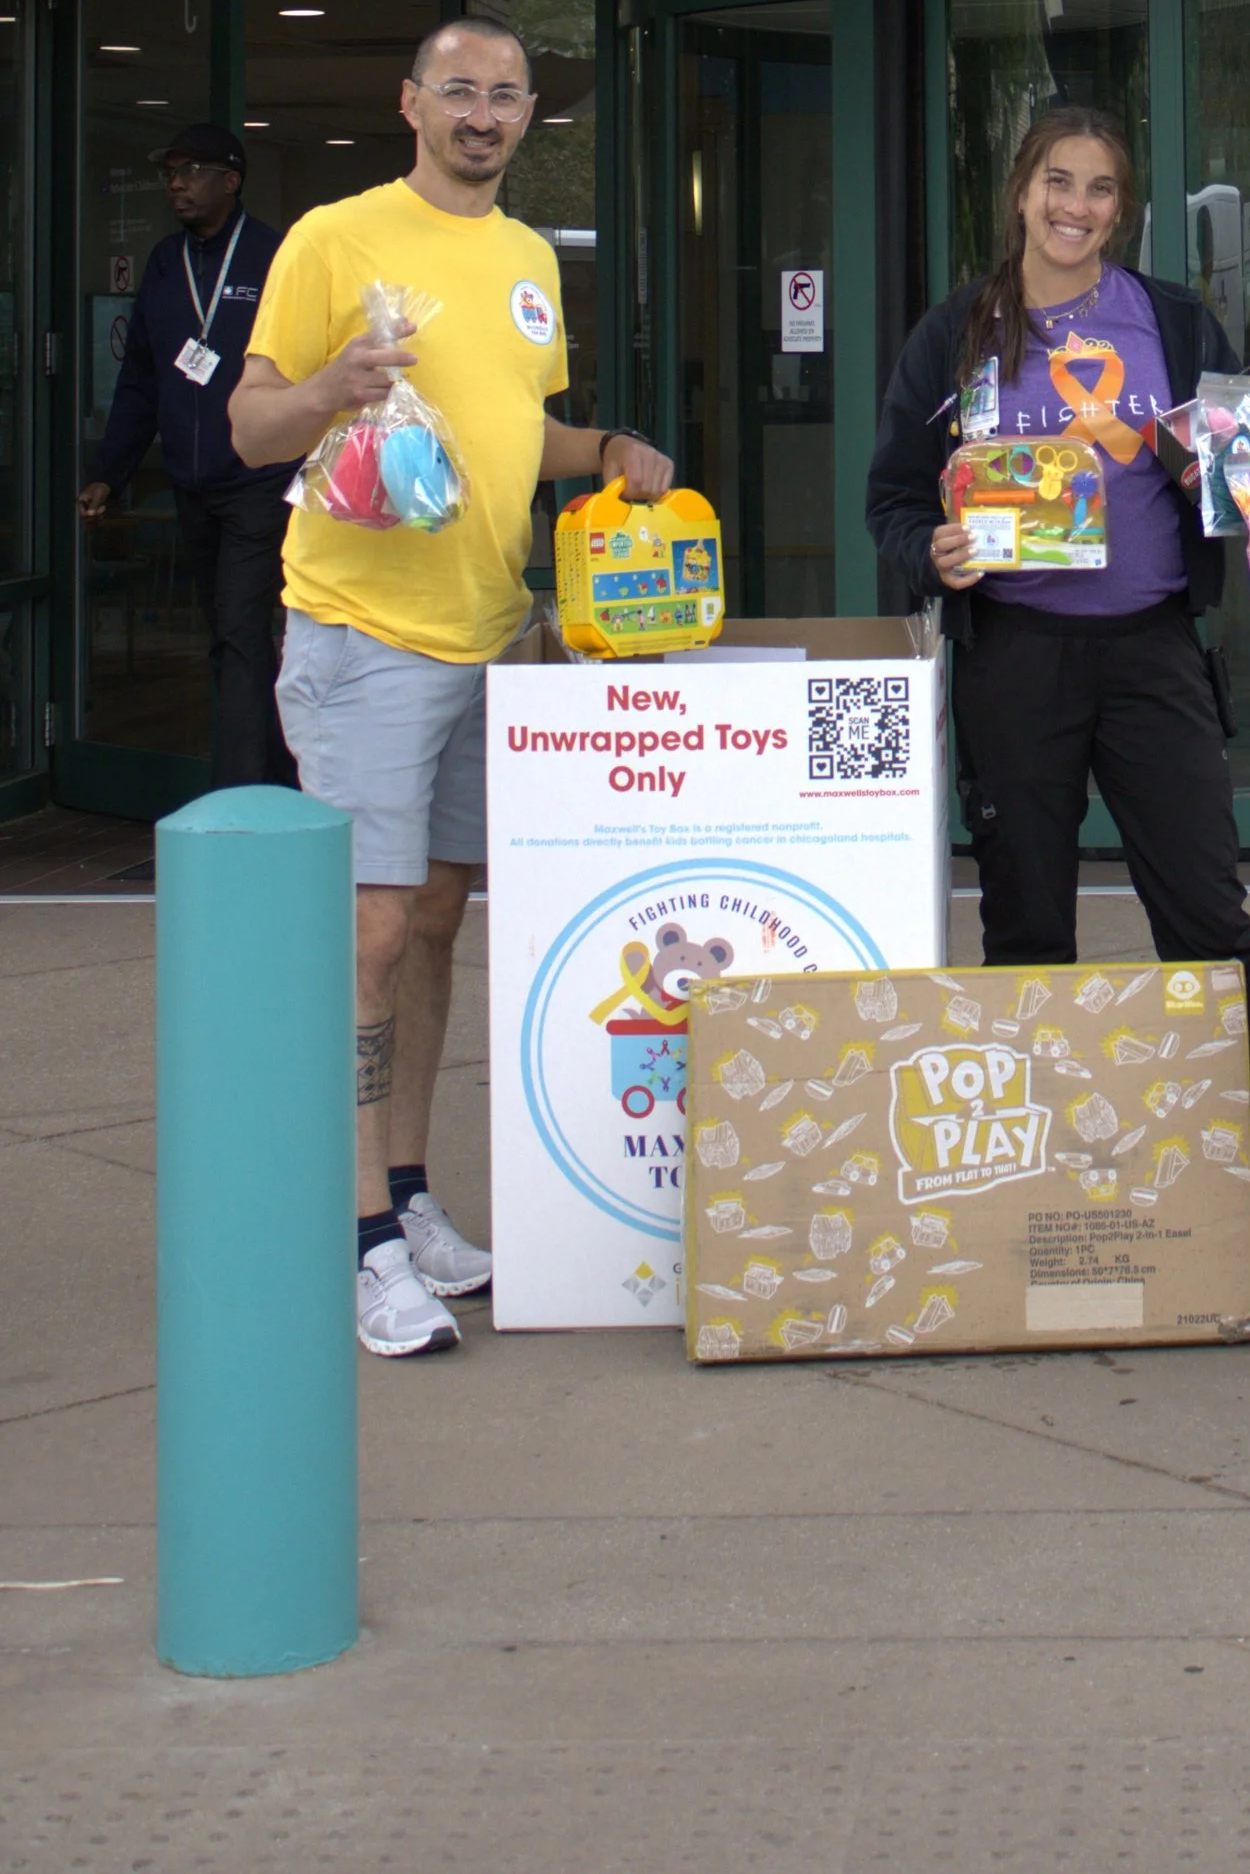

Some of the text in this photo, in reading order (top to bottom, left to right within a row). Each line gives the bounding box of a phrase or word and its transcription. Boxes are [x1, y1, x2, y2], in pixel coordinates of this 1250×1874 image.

[1016, 394, 1164, 435] FIGHTER
[607, 685, 687, 716] New,
[848, 717, 870, 725] SCAN
[508, 723, 788, 758] Unwrapped Toys
[848, 726, 870, 740] ME
[608, 765, 686, 798] Only
[594, 823, 647, 834] Maxwell's
[649, 824, 666, 835] Toy
[669, 823, 689, 833] Box
[715, 821, 769, 834] registered
[526, 837, 580, 847] donations
[582, 837, 623, 848] directly
[625, 836, 663, 846] benefit
[665, 836, 687, 846] kids
[735, 836, 773, 845] cancer
[628, 893, 808, 959] FIGHTING CHILDHOOD
[918, 1048, 1017, 1106] POP
[970, 1098, 984, 1117] 2
[933, 1112, 1040, 1169] PLAY
[915, 1173, 953, 1192] FROM
[955, 1169, 979, 1184] FLAT
[980, 1167, 992, 1177] TO
[1028, 1212, 1043, 1222] PO
[1045, 1211, 1064, 1222] NO:
[1028, 1223, 1053, 1233] ITEM
[1029, 1233, 1087, 1245] Description:
[1089, 1231, 1134, 1243] Pop2Play
[1165, 1228, 1192, 1238] Easel
[1029, 1244, 1096, 1257] Quantity: 1PC
[1030, 1257, 1066, 1268] Weight:
[1115, 1254, 1130, 1264] KG
[1030, 1268, 1090, 1279] Dimensions:
[1141, 1265, 1156, 1274] cm
